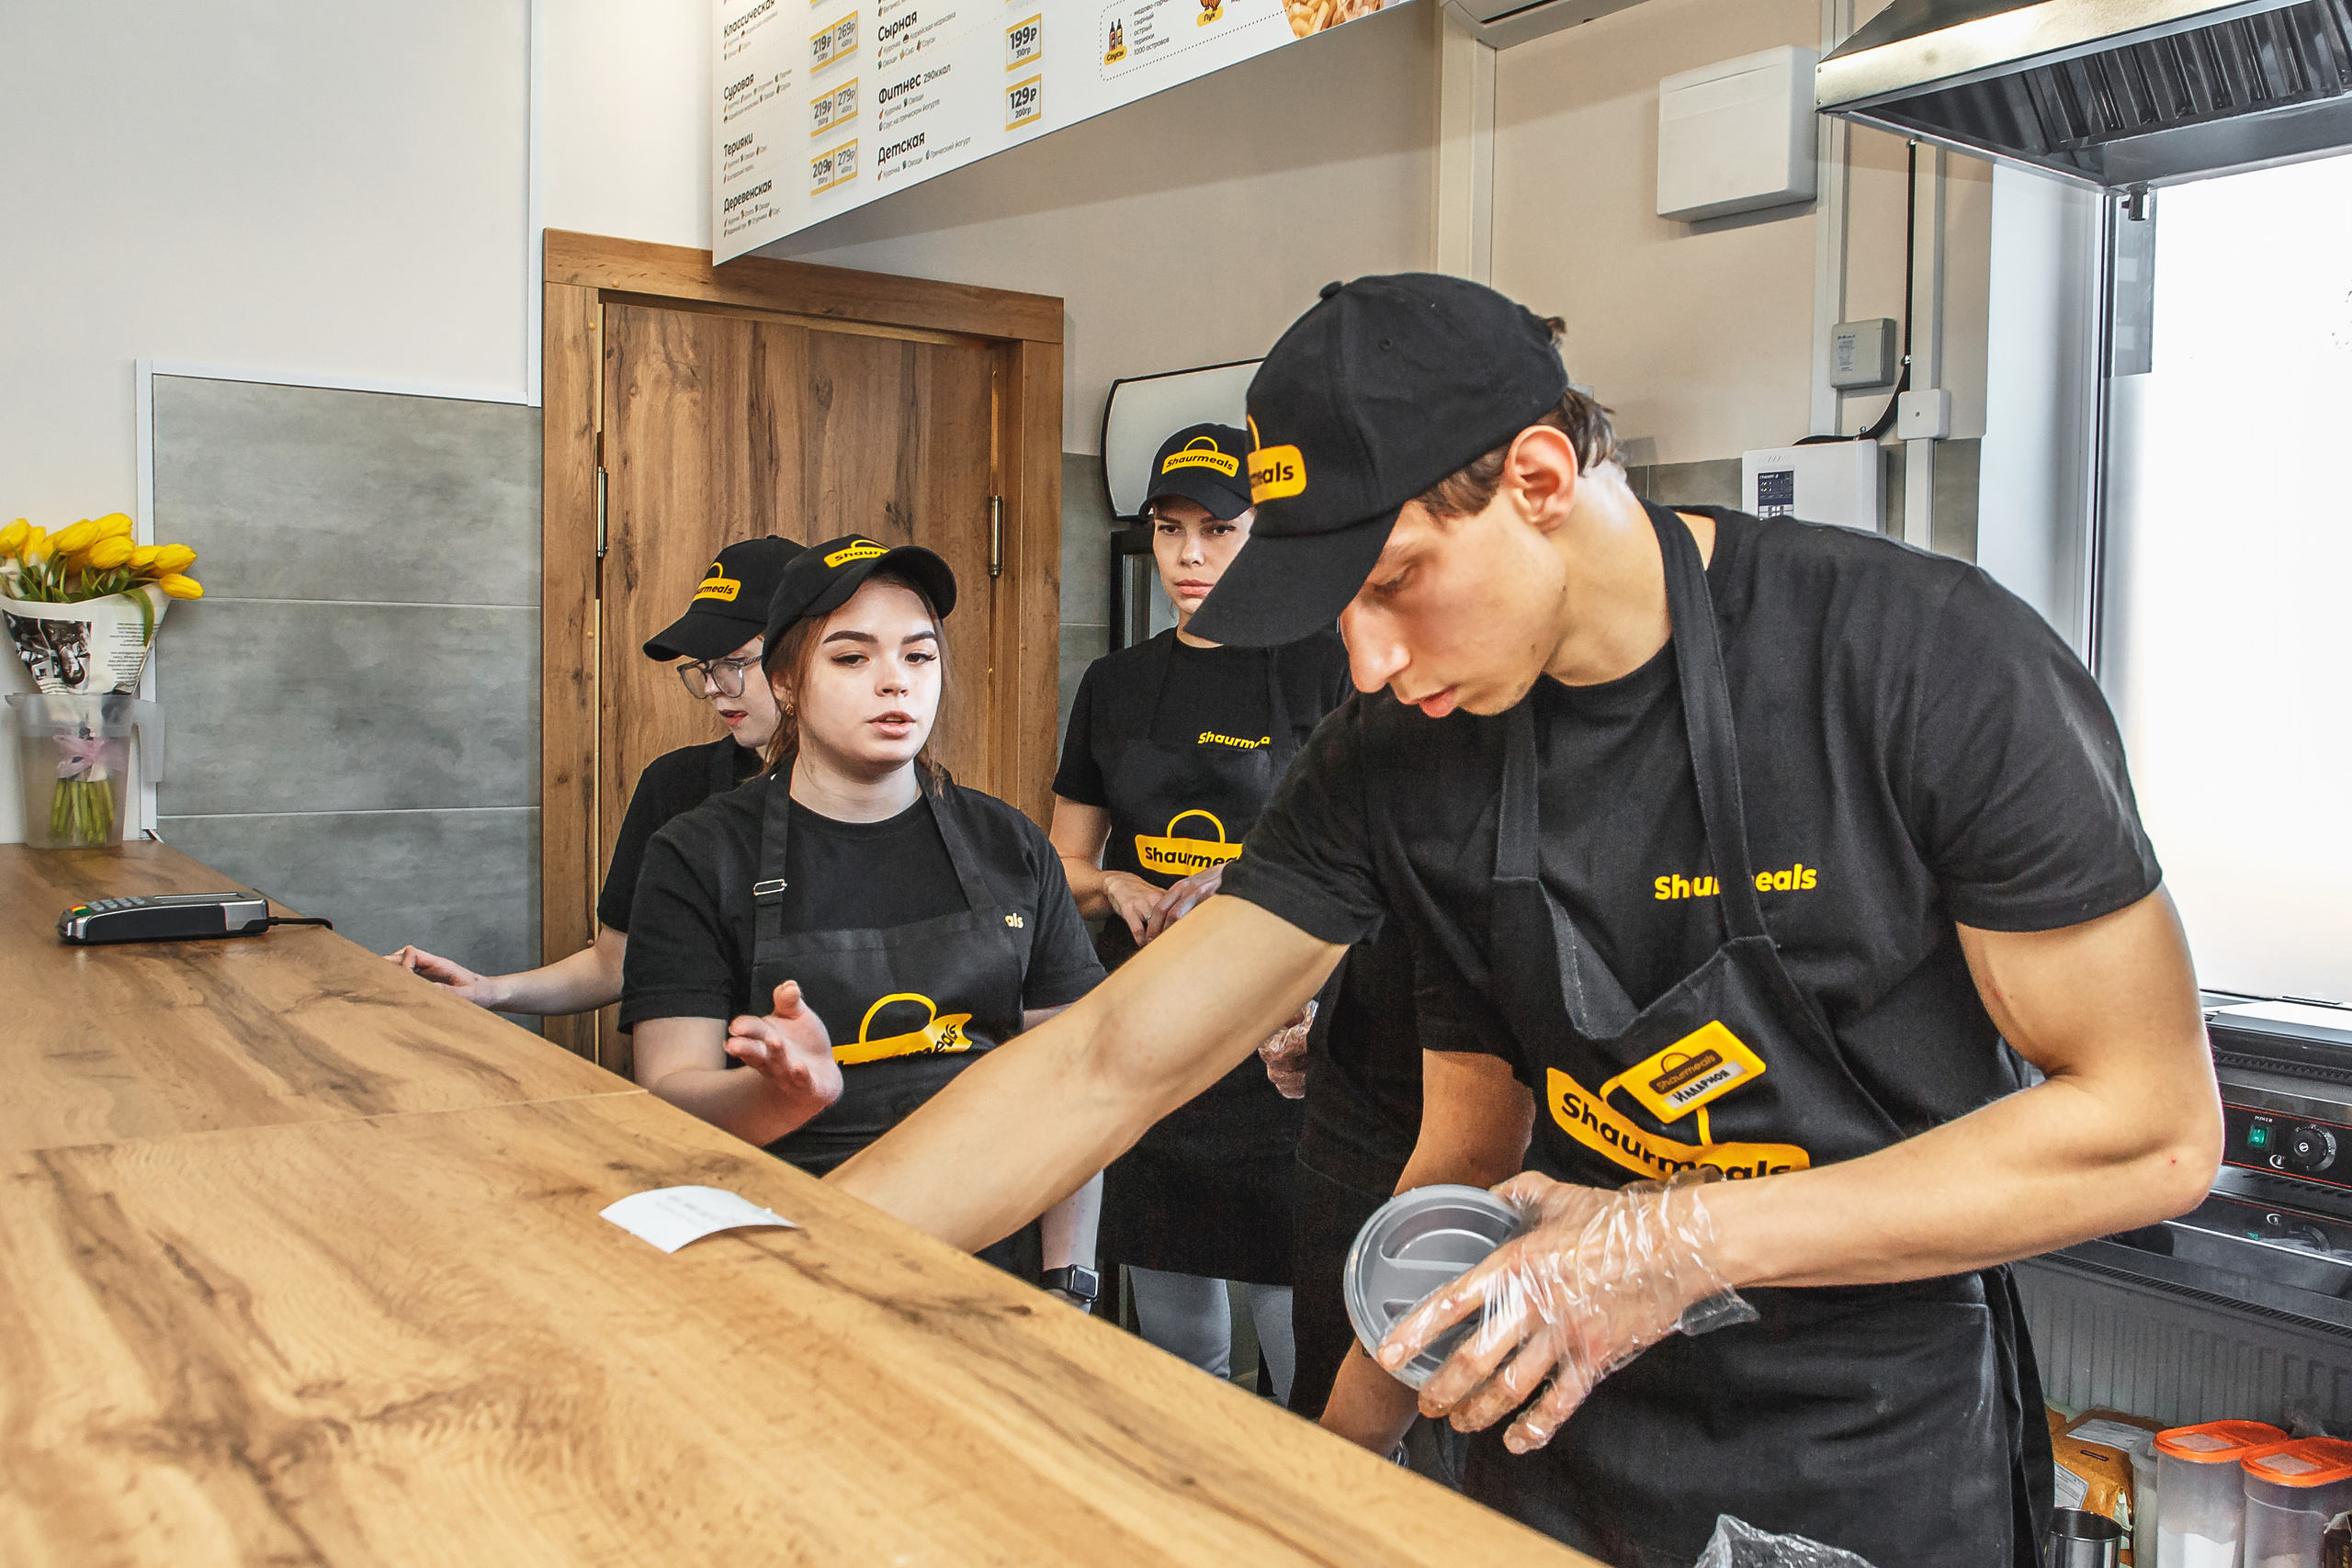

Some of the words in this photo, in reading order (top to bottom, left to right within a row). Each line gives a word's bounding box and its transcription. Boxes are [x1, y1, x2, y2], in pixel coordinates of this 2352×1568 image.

[878, 11, 918, 41] Сырная
[1133, 23, 1153, 36] острый
[1106, 49, 1125, 62] Соусы
[1133, 46, 1146, 56] 1000
[724, 73, 754, 101] Суровая
[878, 73, 922, 105] Фитнес
[724, 132, 753, 157] Терияки
[877, 131, 925, 166] Детская
[724, 179, 773, 214] Деревенская
[1166, 455, 1233, 471] Shaurmeals
